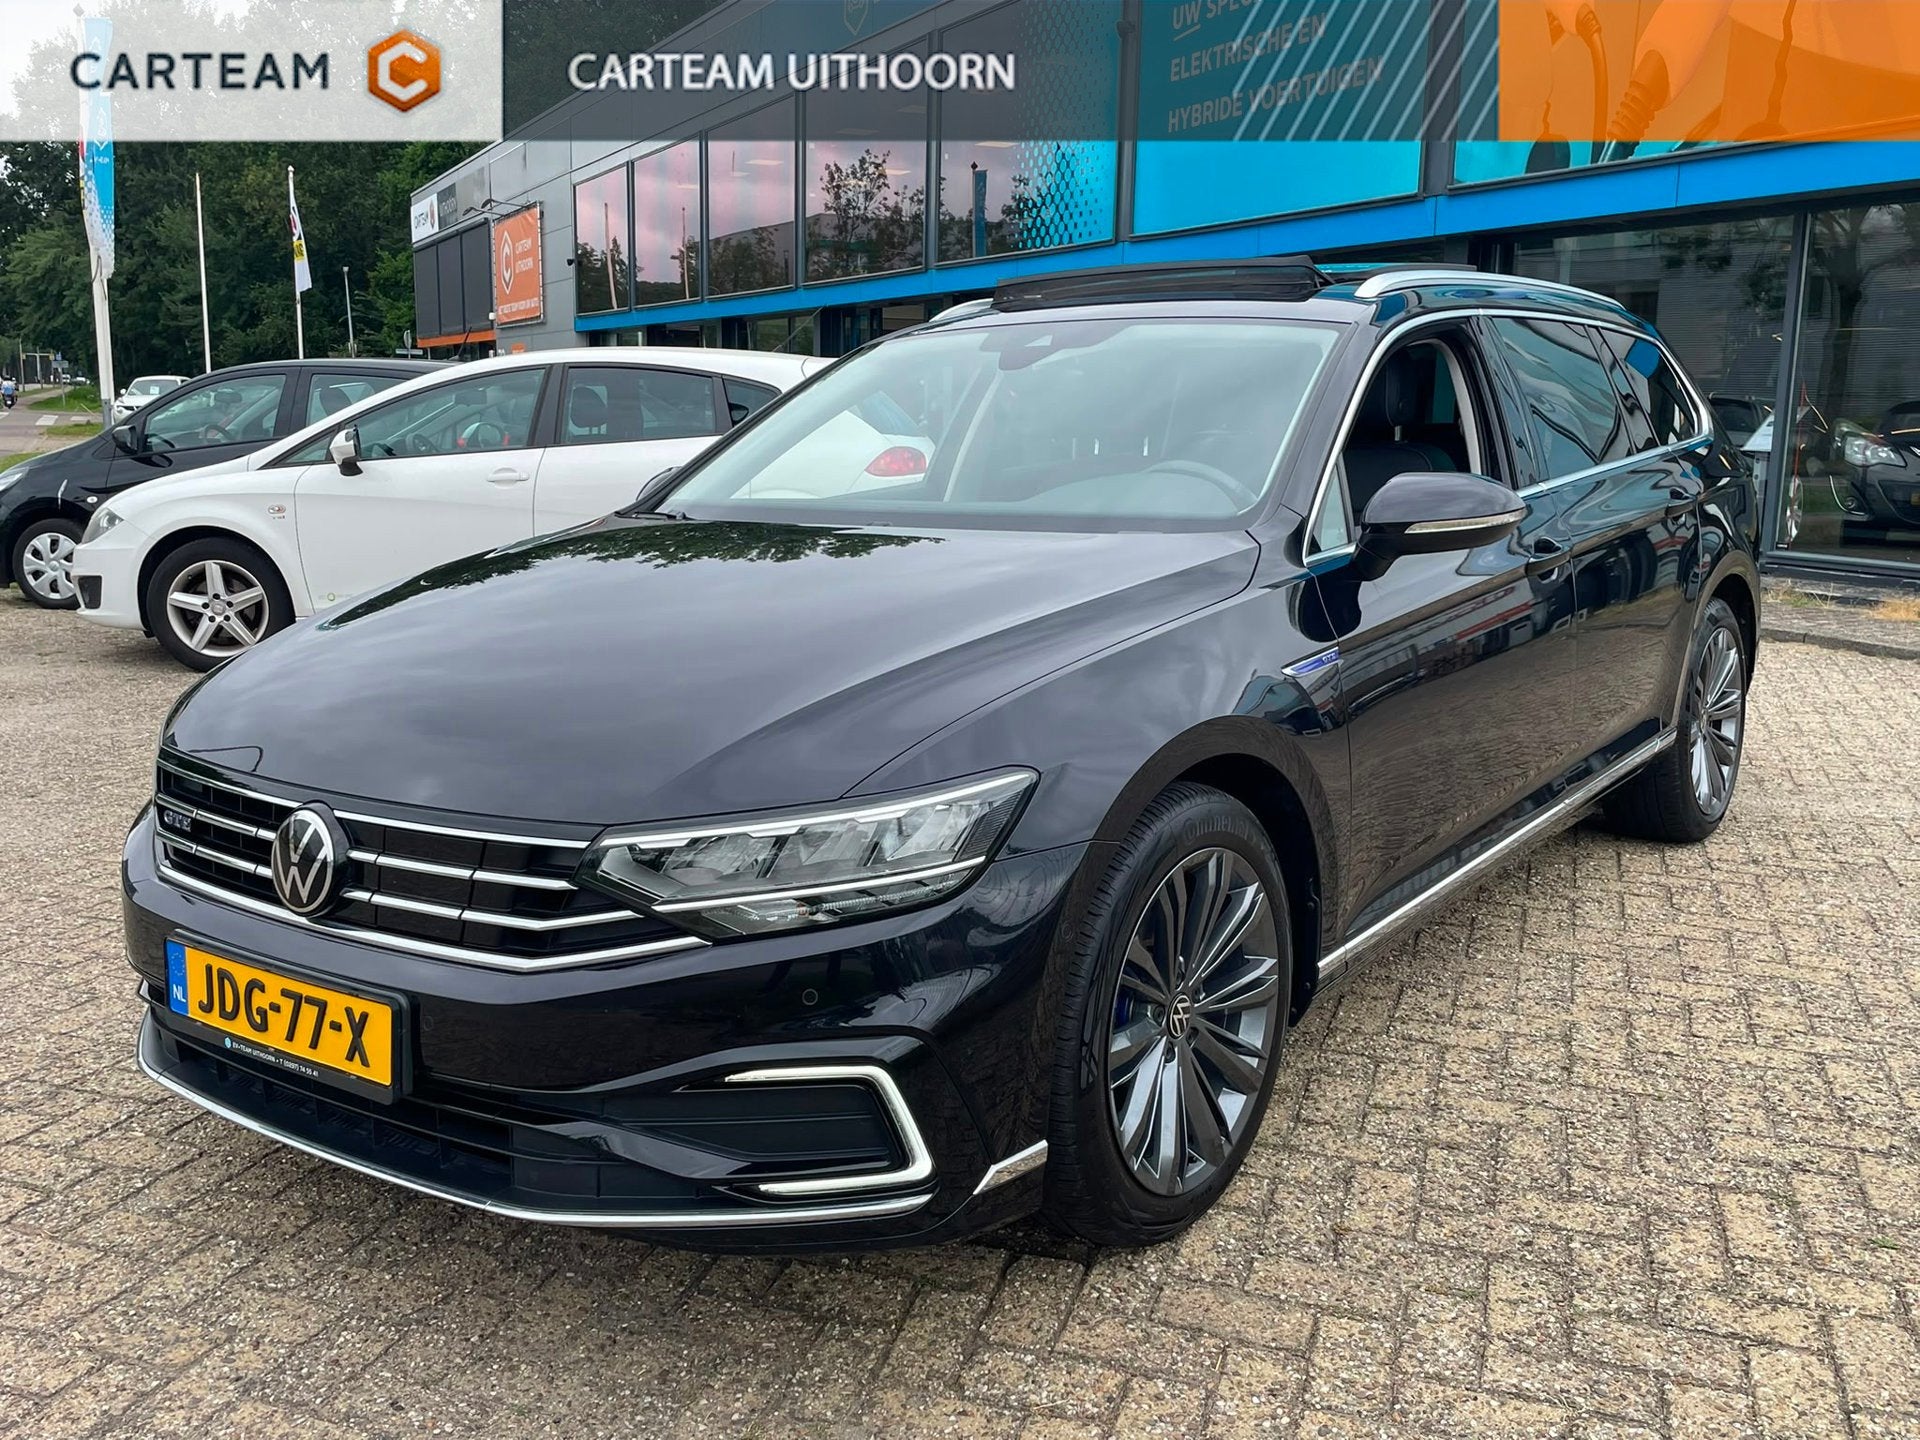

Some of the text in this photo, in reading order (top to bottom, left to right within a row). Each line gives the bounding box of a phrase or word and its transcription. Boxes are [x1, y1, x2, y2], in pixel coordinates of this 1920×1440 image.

[1172, 0, 1201, 30] UW
[1170, 13, 1328, 82] ELEKTRISCHE EN
[1168, 55, 1385, 133] HYBRIDE VOERTUIGEN
[163, 810, 192, 833] GTE
[172, 984, 187, 1003] NL
[198, 964, 370, 1068] JDG-77-X
